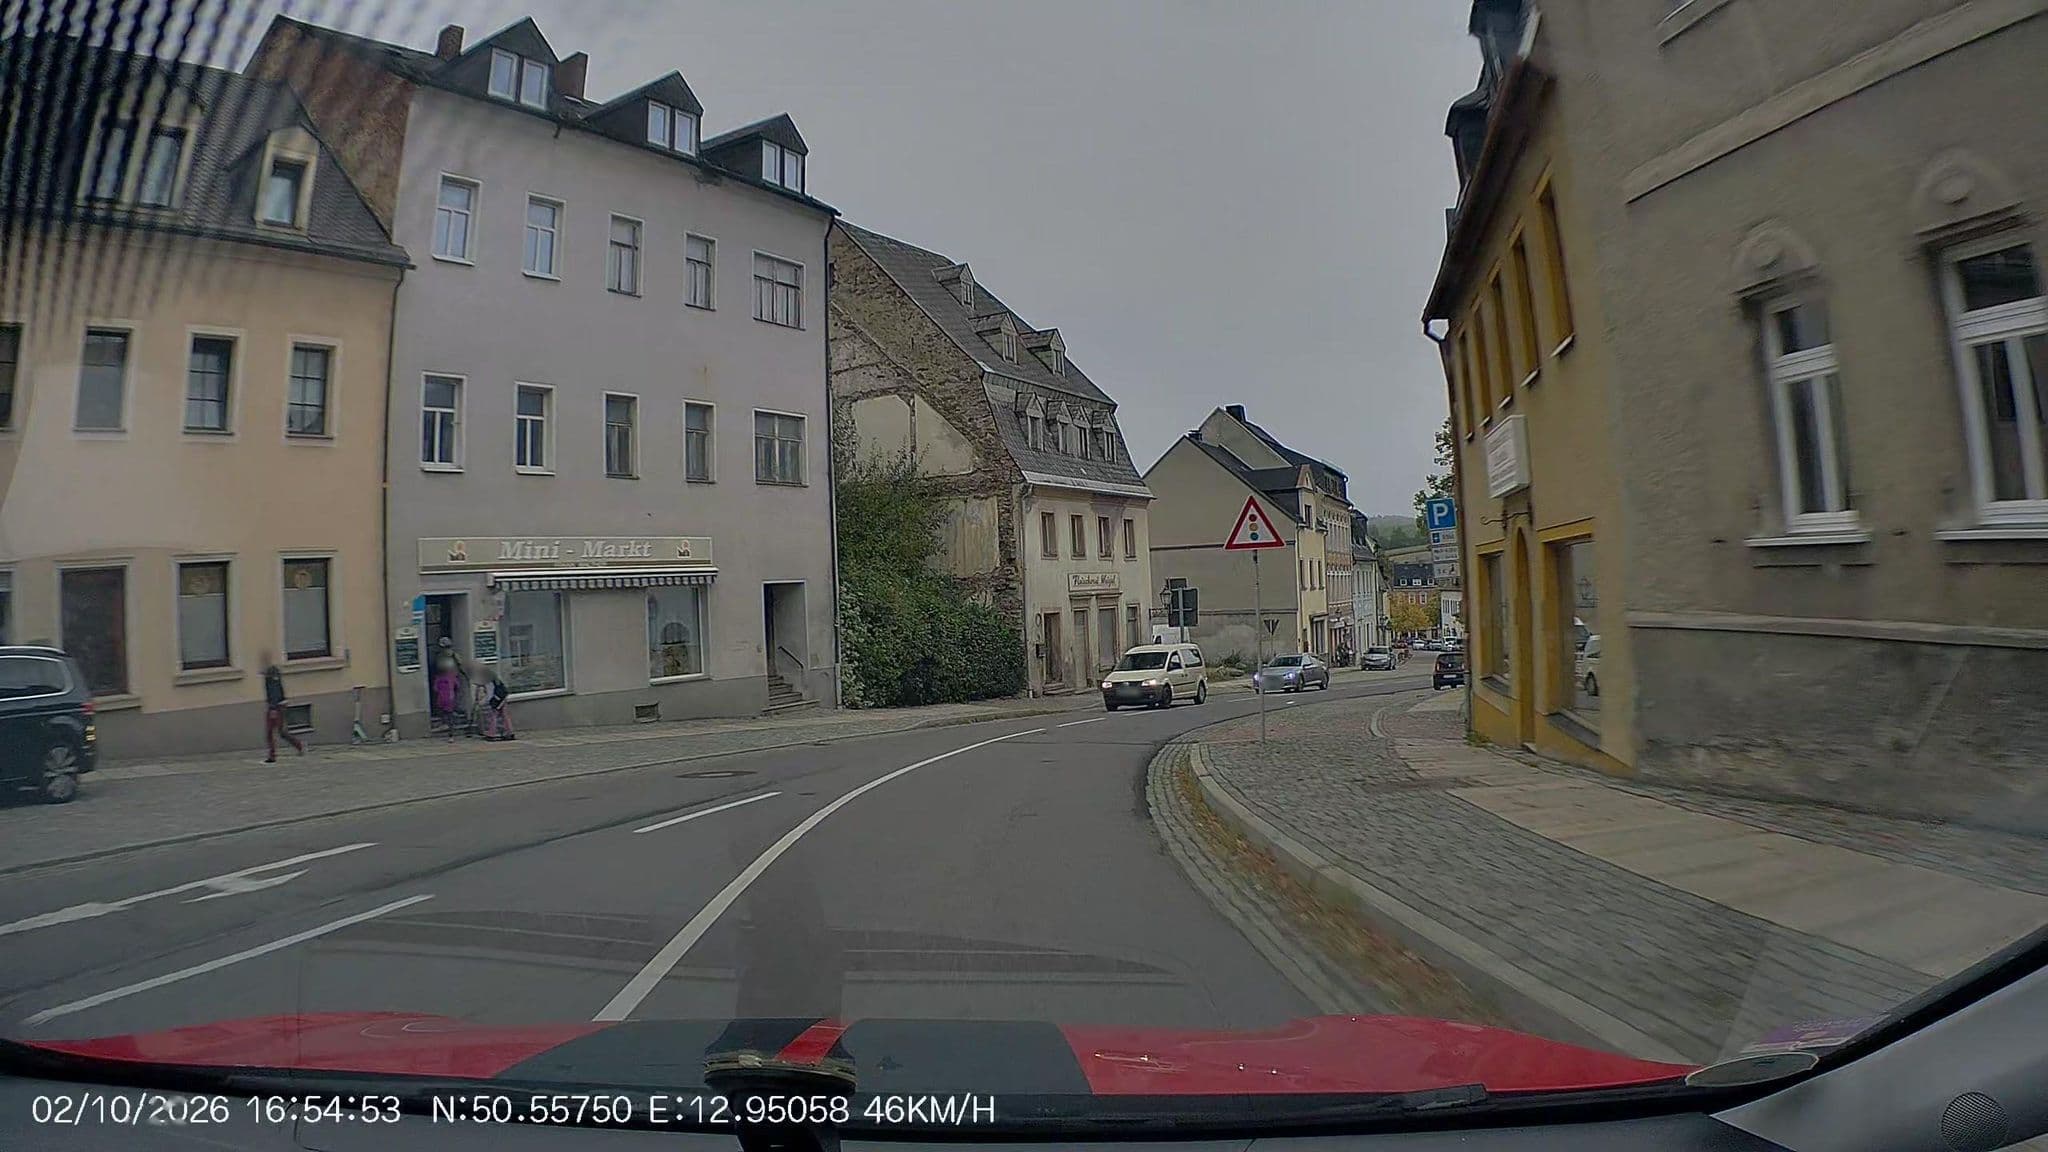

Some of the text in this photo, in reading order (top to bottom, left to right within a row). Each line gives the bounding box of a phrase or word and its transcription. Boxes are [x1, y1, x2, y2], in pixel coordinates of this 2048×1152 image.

[1432, 503, 1449, 526] P
[498, 540, 560, 560] Mini
[580, 540, 652, 559] Markt
